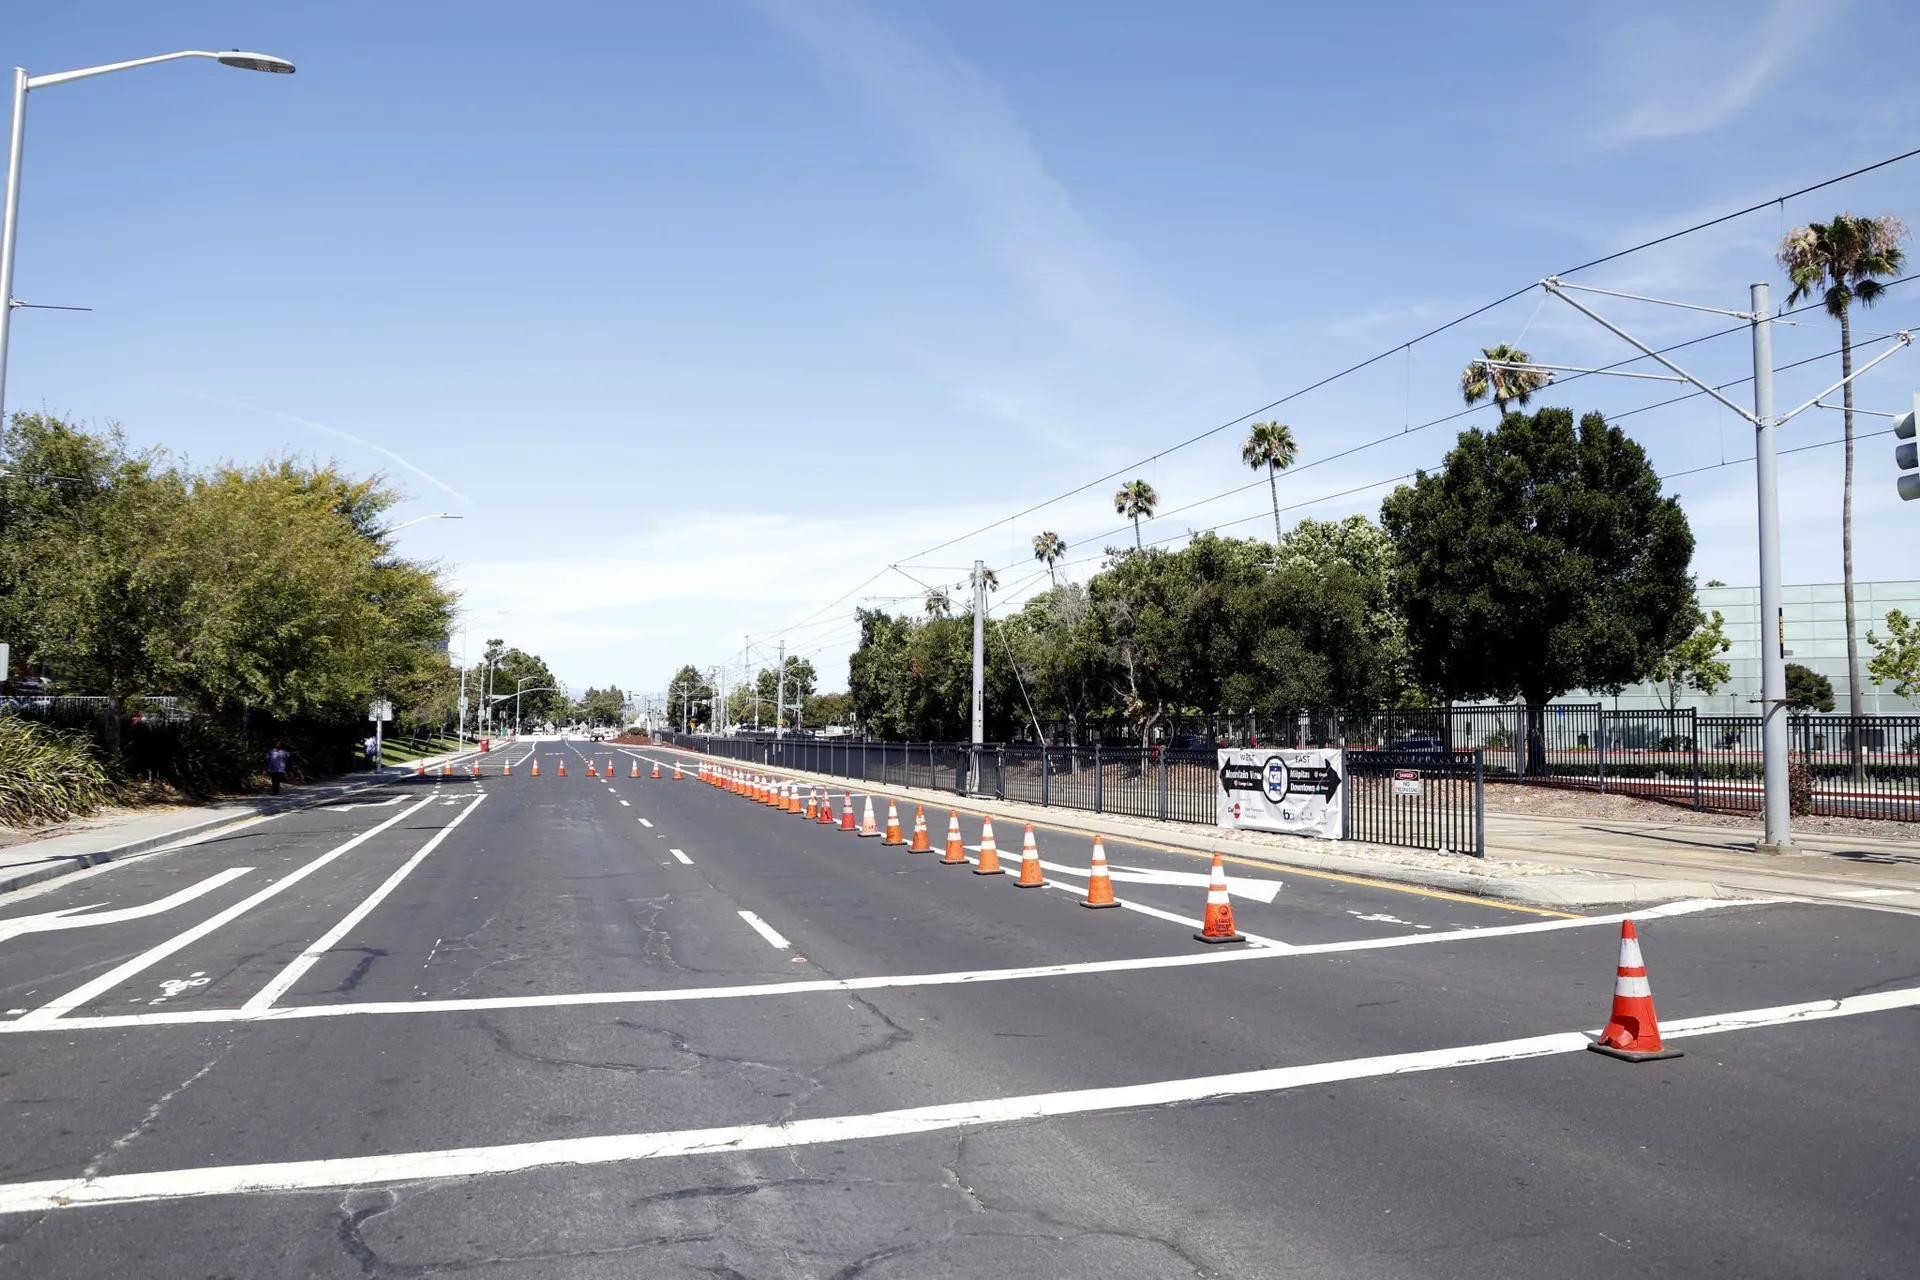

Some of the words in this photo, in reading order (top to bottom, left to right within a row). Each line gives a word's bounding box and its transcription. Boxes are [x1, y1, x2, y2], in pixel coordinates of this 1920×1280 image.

[1239, 753, 1255, 762] WEST
[1295, 755, 1310, 763] EAST
[1225, 769, 1249, 779] Mountain
[1249, 770, 1263, 780] View
[1290, 769, 1310, 779] Milpitas
[1290, 783, 1315, 792] Downtown
